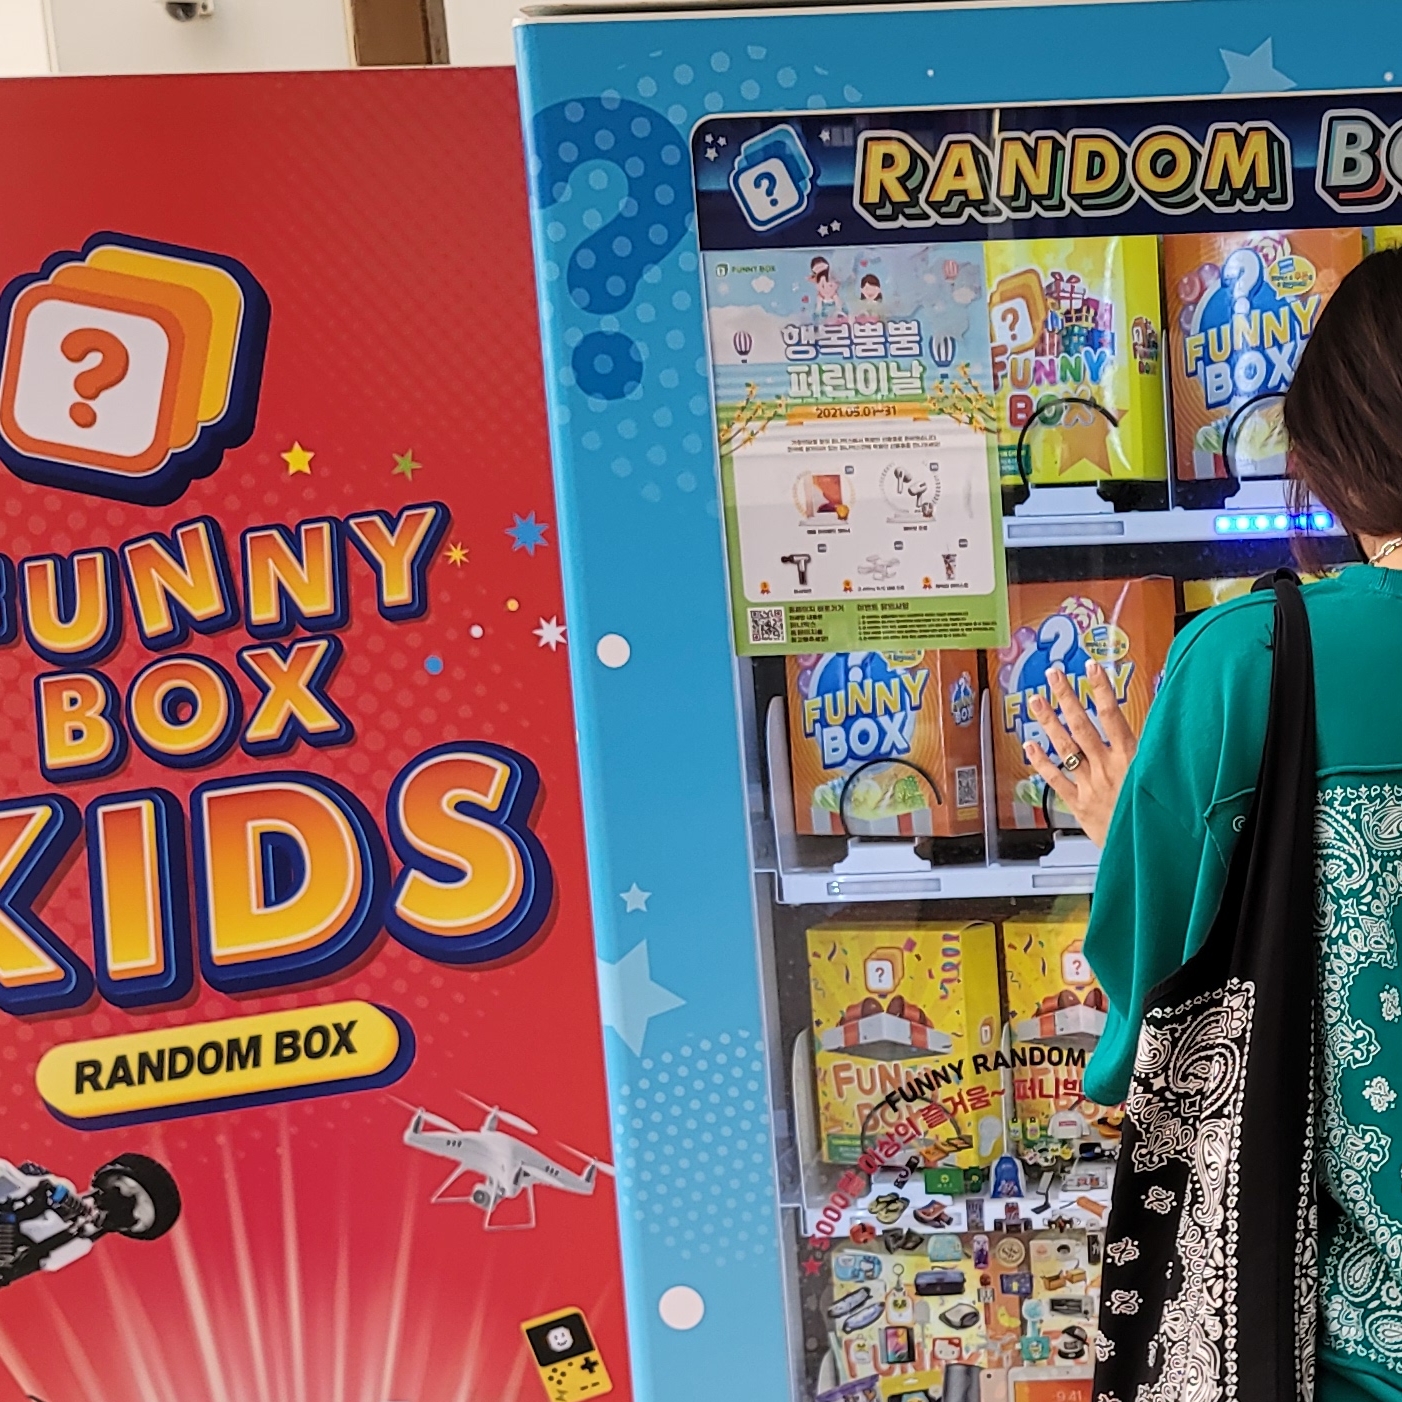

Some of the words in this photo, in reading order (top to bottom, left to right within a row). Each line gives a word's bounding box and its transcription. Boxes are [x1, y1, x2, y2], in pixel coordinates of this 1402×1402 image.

[858, 123, 1287, 222] RANDOM
[781, 320, 923, 362] 행복뿜뿜
[990, 343, 1108, 392] FUNNY
[1184, 294, 1321, 377] FUNNY
[787, 361, 927, 402] 퍼린이날
[1009, 386, 1096, 428] BOX
[1203, 341, 1307, 409] BOX
[0, 504, 444, 660] UNNY
[38, 637, 350, 777] BOX
[804, 668, 930, 738] FUNNY
[821, 711, 911, 769] BOX
[0, 744, 542, 1005] KIDS
[73, 1028, 262, 1097] RANDOM
[272, 1019, 359, 1067] BOX
[886, 1059, 964, 1113] FUNNY
[972, 1046, 1086, 1075] RANDOM
[857, 1117, 922, 1175] 이상의
[1013, 1077, 1086, 1103] 퍼니박
